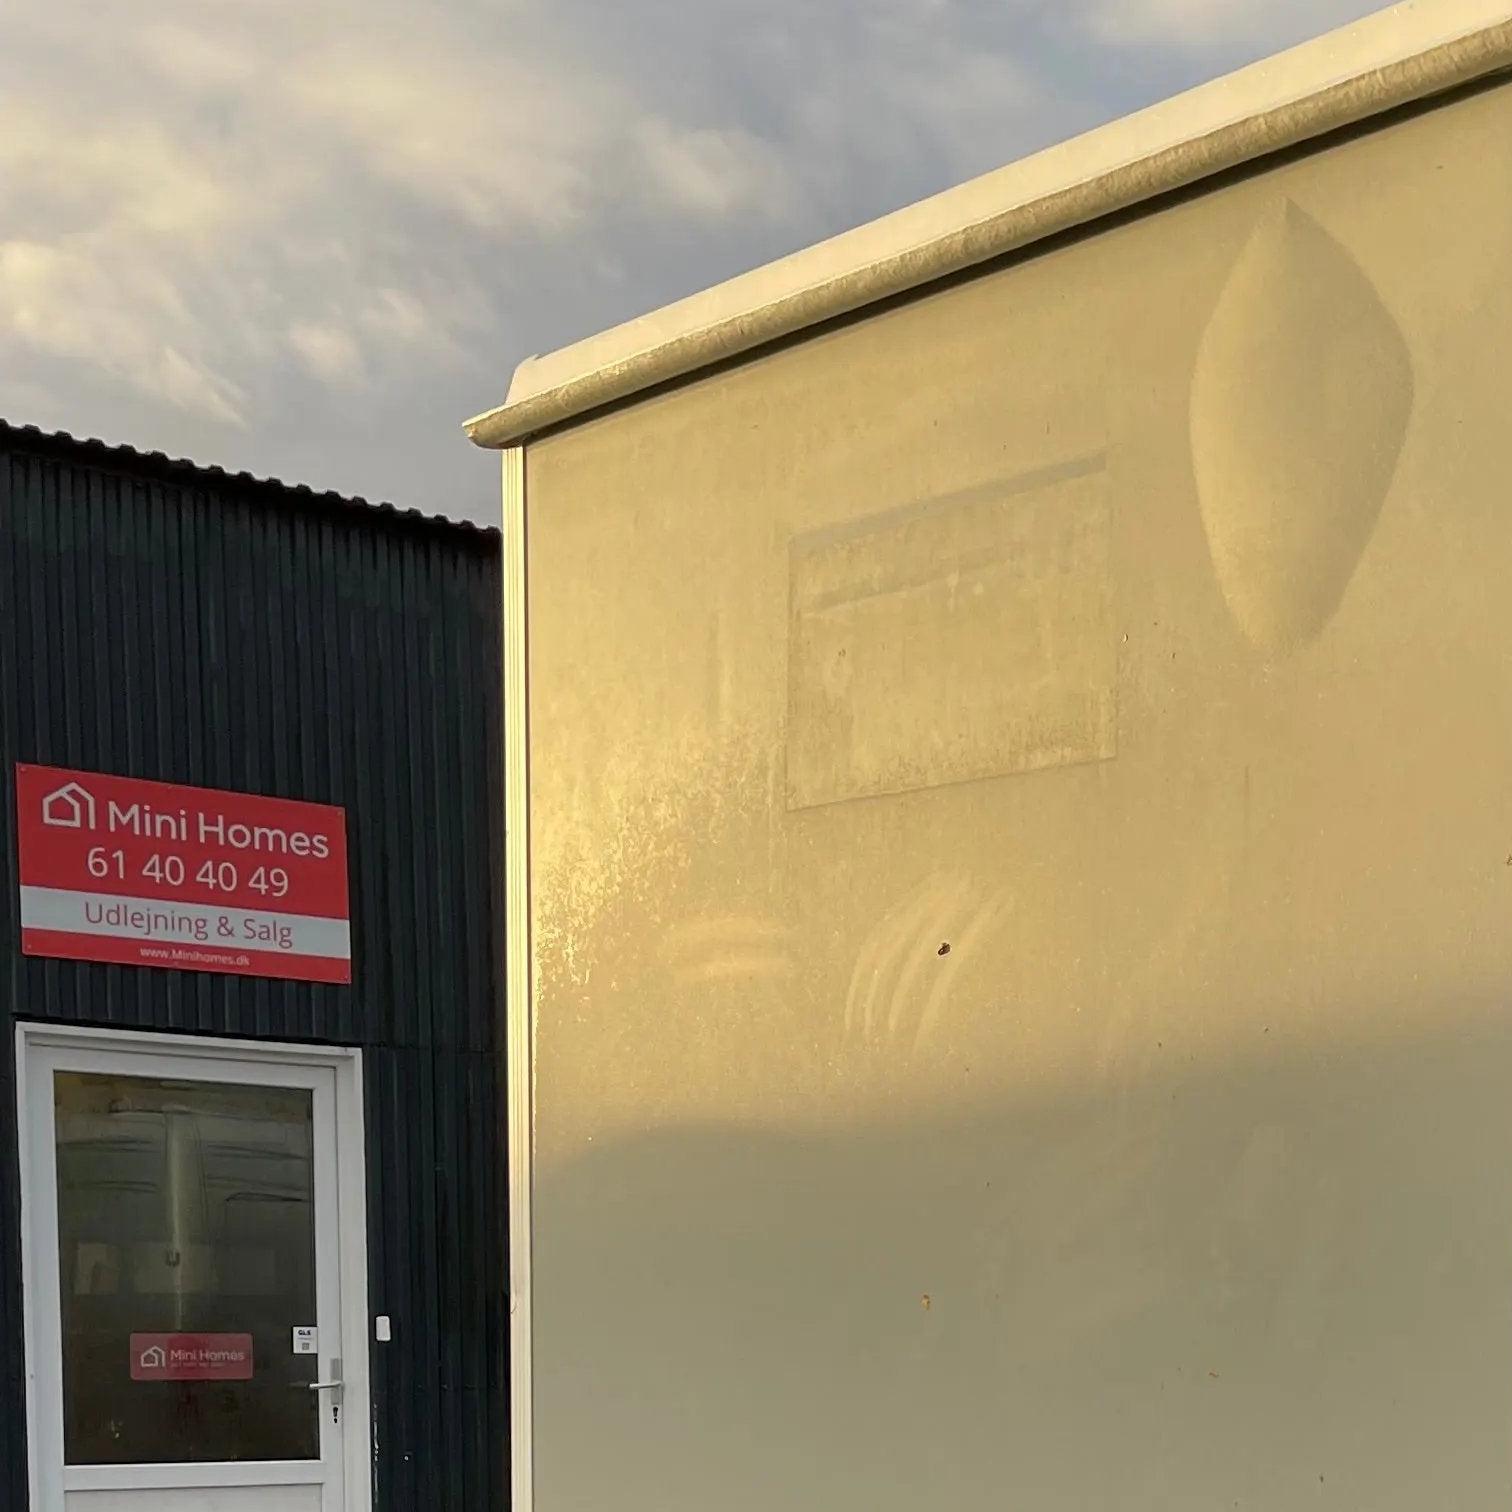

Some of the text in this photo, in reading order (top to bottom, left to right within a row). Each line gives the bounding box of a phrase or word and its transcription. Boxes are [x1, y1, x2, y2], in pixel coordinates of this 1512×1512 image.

[108, 800, 330, 859] Mini Homes
[87, 847, 289, 897] 61 40 40 49
[85, 901, 293, 949] Udlejning & Salg
[170, 1349, 245, 1361] Mini Homes
